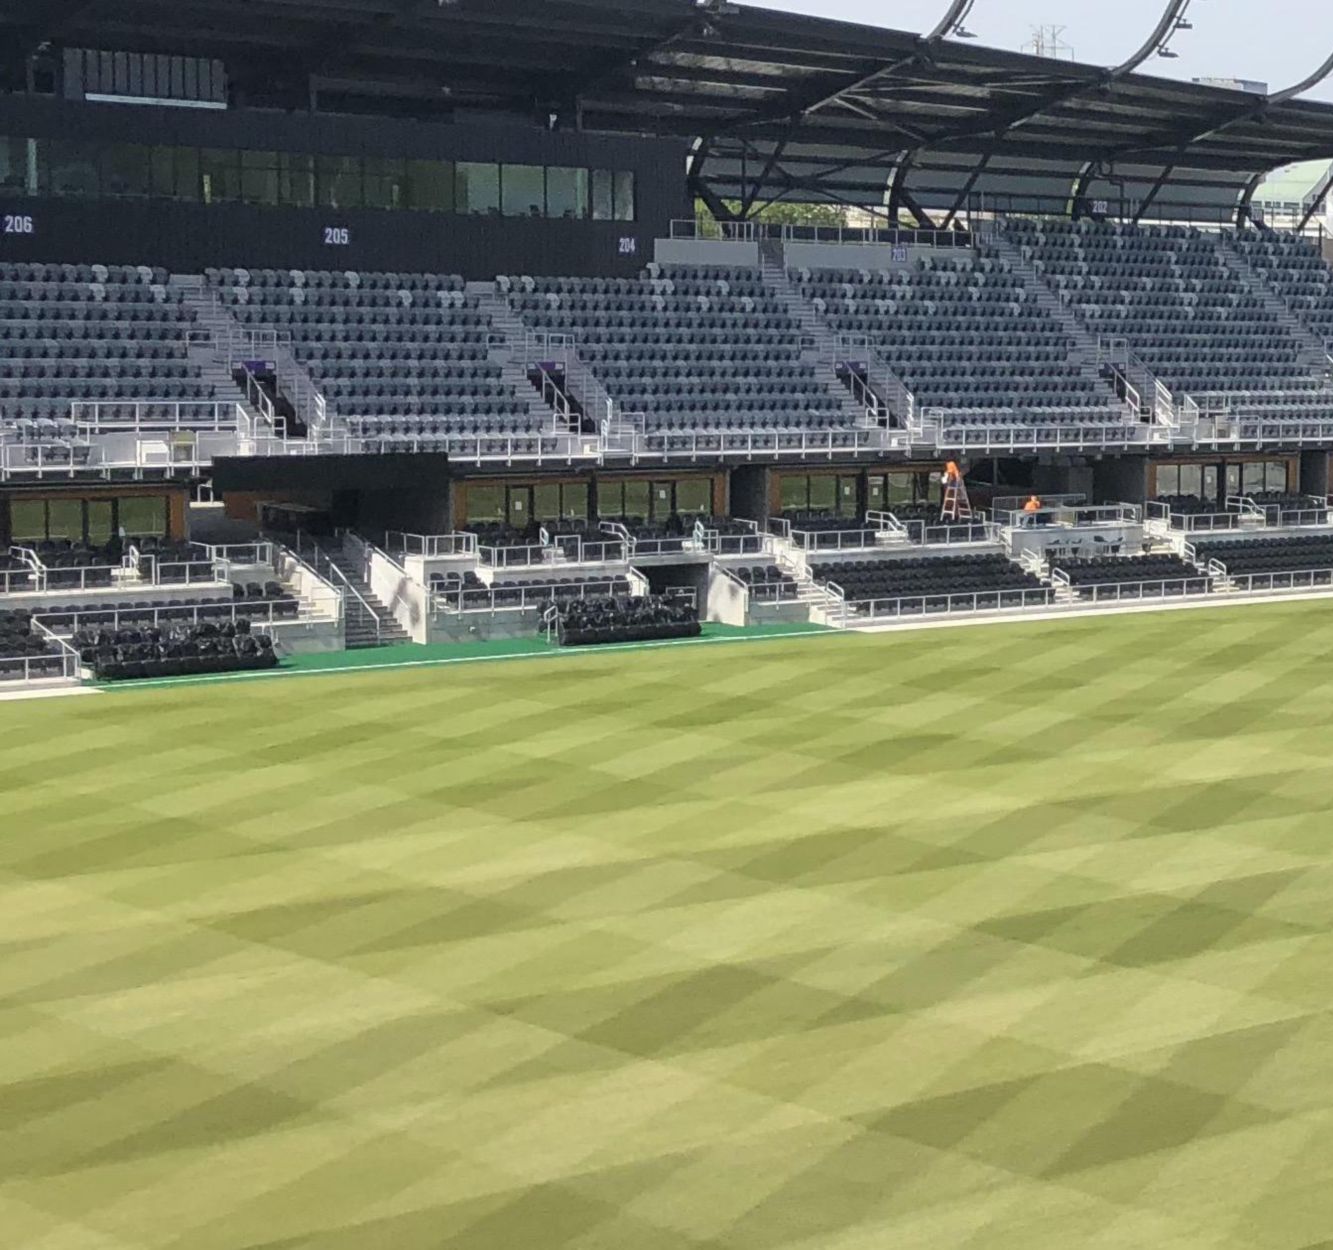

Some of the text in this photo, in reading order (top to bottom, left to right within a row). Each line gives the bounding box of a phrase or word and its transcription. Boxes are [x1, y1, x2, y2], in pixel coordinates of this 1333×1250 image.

[4, 214, 33, 233] 206
[324, 227, 349, 244] 205
[619, 237, 636, 253] 204
